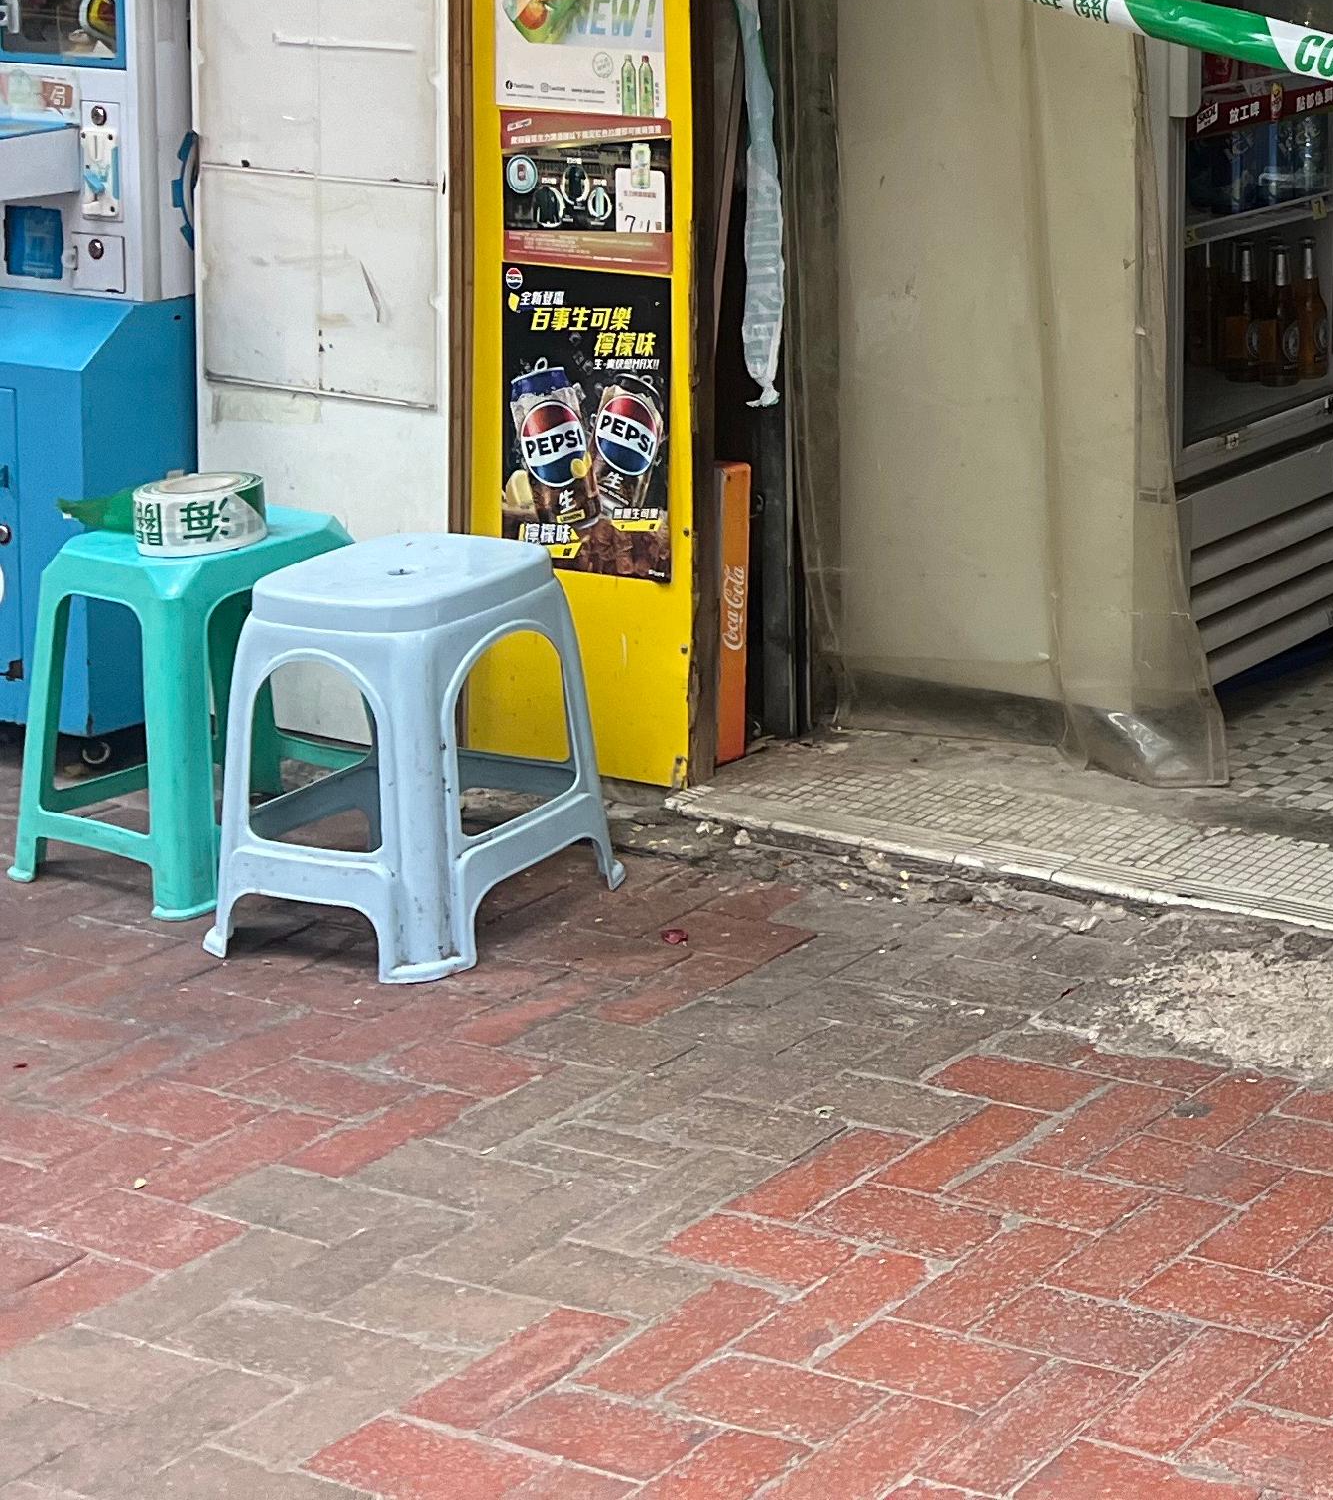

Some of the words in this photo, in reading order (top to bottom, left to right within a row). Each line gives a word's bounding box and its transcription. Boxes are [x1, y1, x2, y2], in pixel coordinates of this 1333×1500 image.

[530, 306, 633, 332] 百事生可樂
[593, 332, 657, 358] 檸檬味
[525, 428, 583, 459] PEPSI
[599, 410, 655, 459] PEPSI
[602, 470, 624, 490] 生
[557, 488, 578, 513] 生
[722, 564, 745, 652] Coca-Cola
